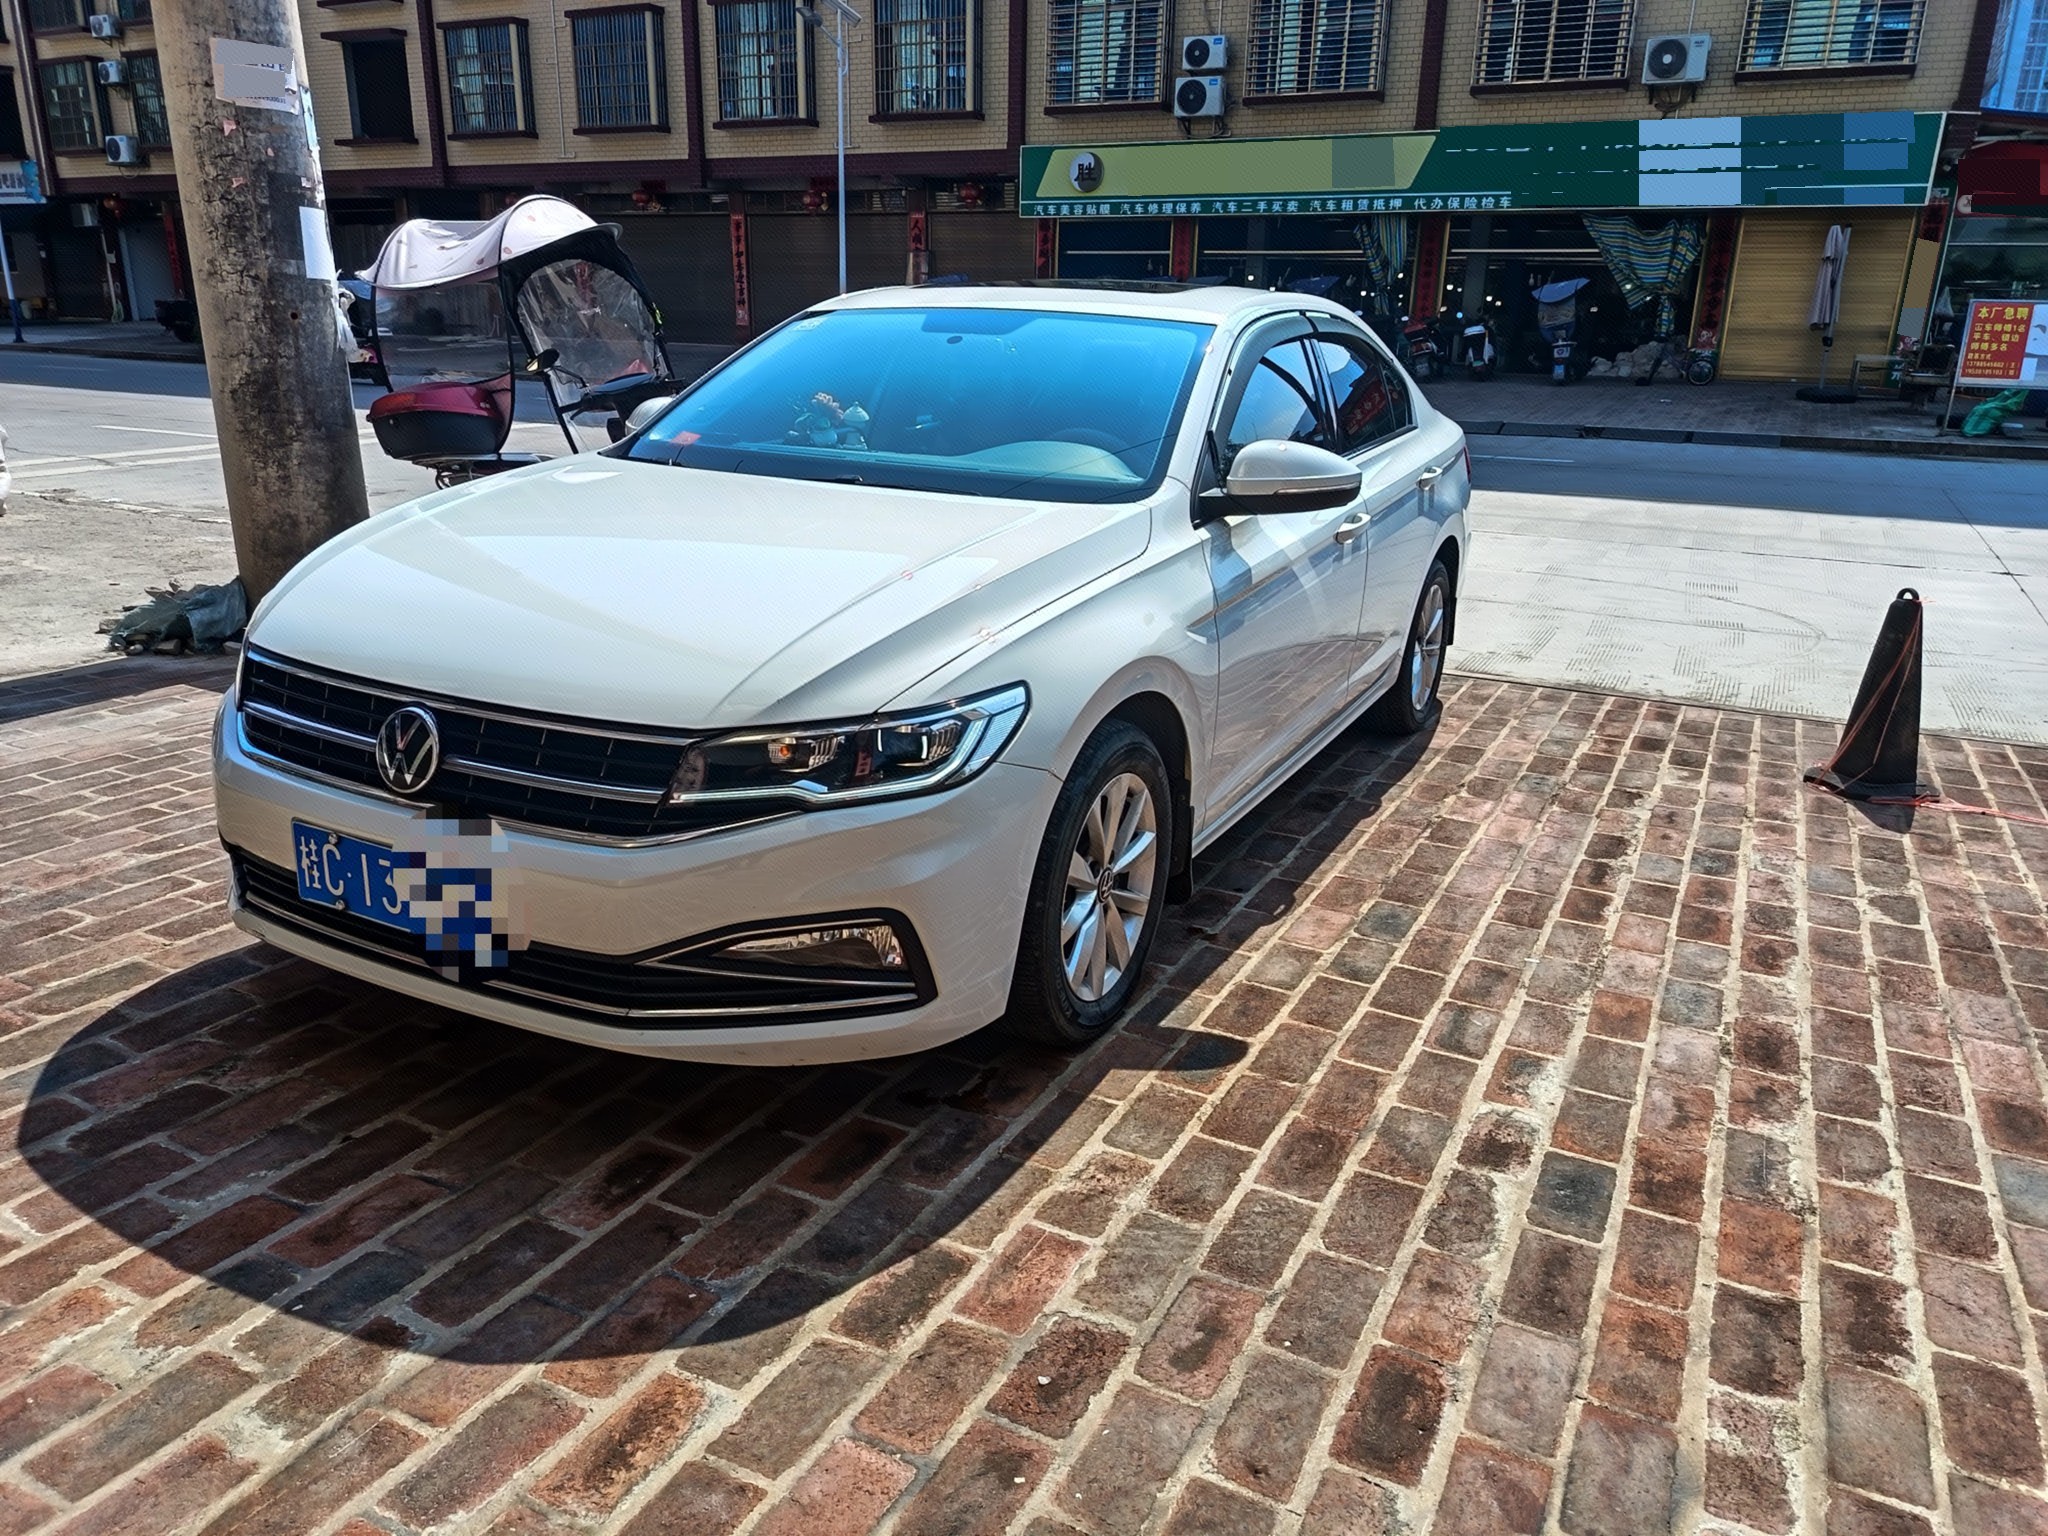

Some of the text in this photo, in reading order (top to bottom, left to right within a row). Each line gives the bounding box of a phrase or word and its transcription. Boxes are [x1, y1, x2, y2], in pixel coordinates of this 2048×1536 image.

[1074, 162, 1098, 181] 胜
[1033, 196, 1512, 216] 汽车美容贴膜 汽车修理保养 汽车二手买卖 汽车租赁抵押 代办保险检车
[1978, 306, 2029, 320] 本厂急聘
[1970, 342, 2009, 352] 师傅多名
